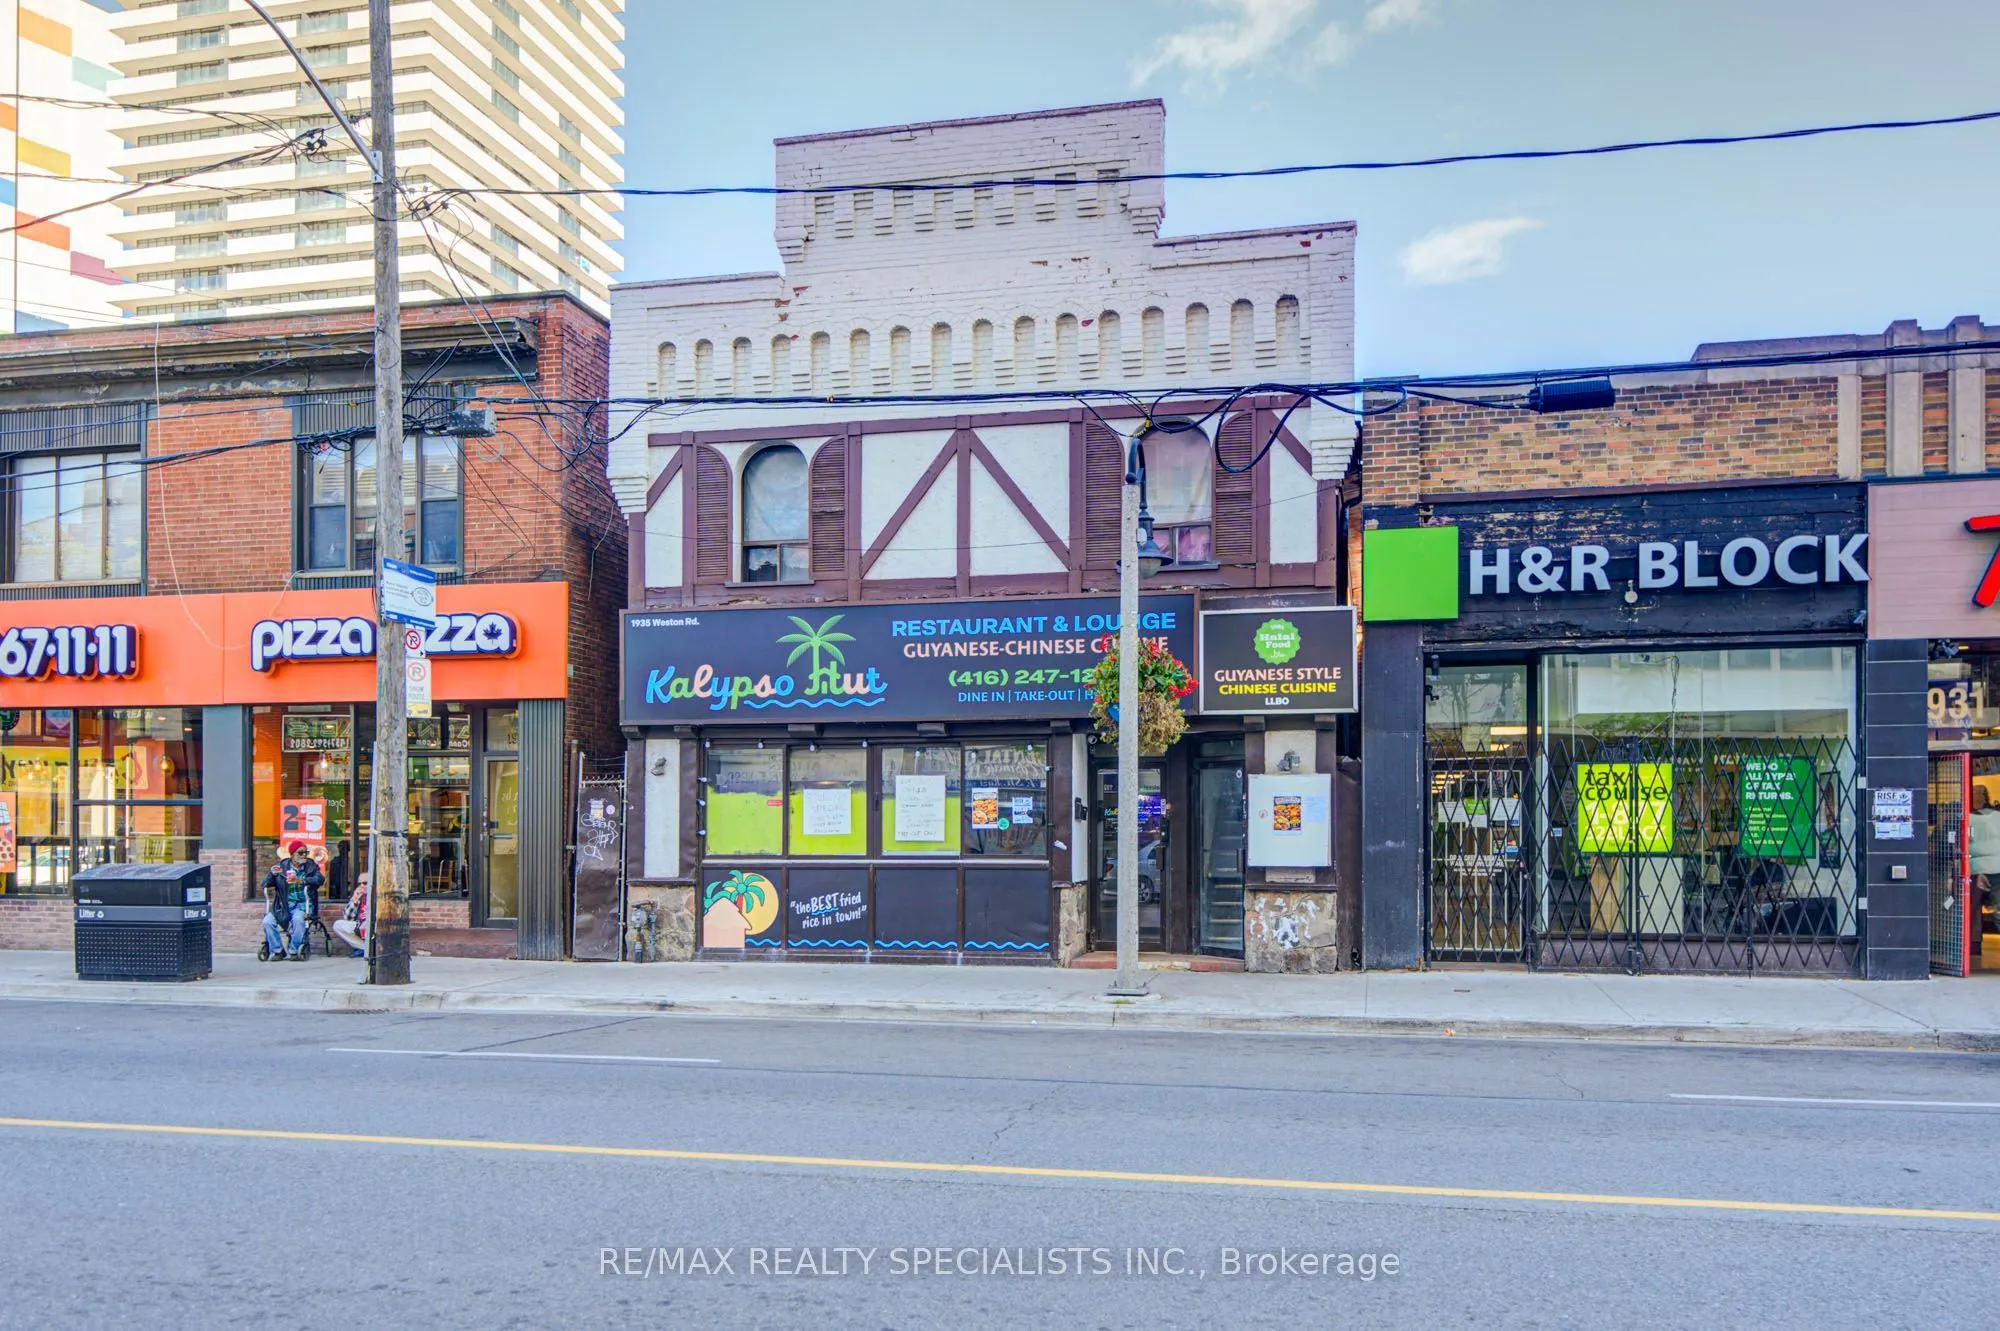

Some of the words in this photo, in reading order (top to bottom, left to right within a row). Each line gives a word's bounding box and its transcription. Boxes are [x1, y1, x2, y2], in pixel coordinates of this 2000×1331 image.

[1470, 544, 1611, 595] H&R
[1639, 533, 1871, 590] BLOCK
[631, 619, 651, 628] 1935
[652, 618, 684, 627] Weston
[686, 617, 700, 626] Rd.
[892, 616, 1048, 637] RESTAURANT
[1053, 615, 1068, 632] &
[1075, 612, 1176, 632] LOUGE
[1260, 632, 1296, 642] Halal
[903, 638, 1086, 658] GUYANESE-CHINESE
[1265, 641, 1291, 650] Food
[948, 668, 1009, 688] (416)
[1214, 668, 1293, 682] GUYANESE
[1296, 667, 1342, 681] STYLE
[646, 664, 795, 710] Kalypso
[1219, 683, 1277, 696] CHINESE
[1280, 682, 1337, 694] CUISINE
[958, 691, 987, 703] DINE
[991, 690, 1005, 702] IN
[1014, 689, 1075, 702] TAKE-OUT
[1265, 697, 1290, 706] LLBO
[1746, 762, 1762, 771] WE
[1585, 769, 1626, 787] tax
[1746, 772, 1762, 781] ALL
[1585, 786, 1667, 801] couse
[1762, 782, 1780, 791] TAX
[284, 804, 299, 831] 2
[811, 892, 839, 912] BEST
[840, 891, 862, 908] fried
[79, 908, 95, 918] Litter
[184, 909, 200, 919] Litter
[802, 915, 820, 929] rice
[822, 914, 832, 926] in
